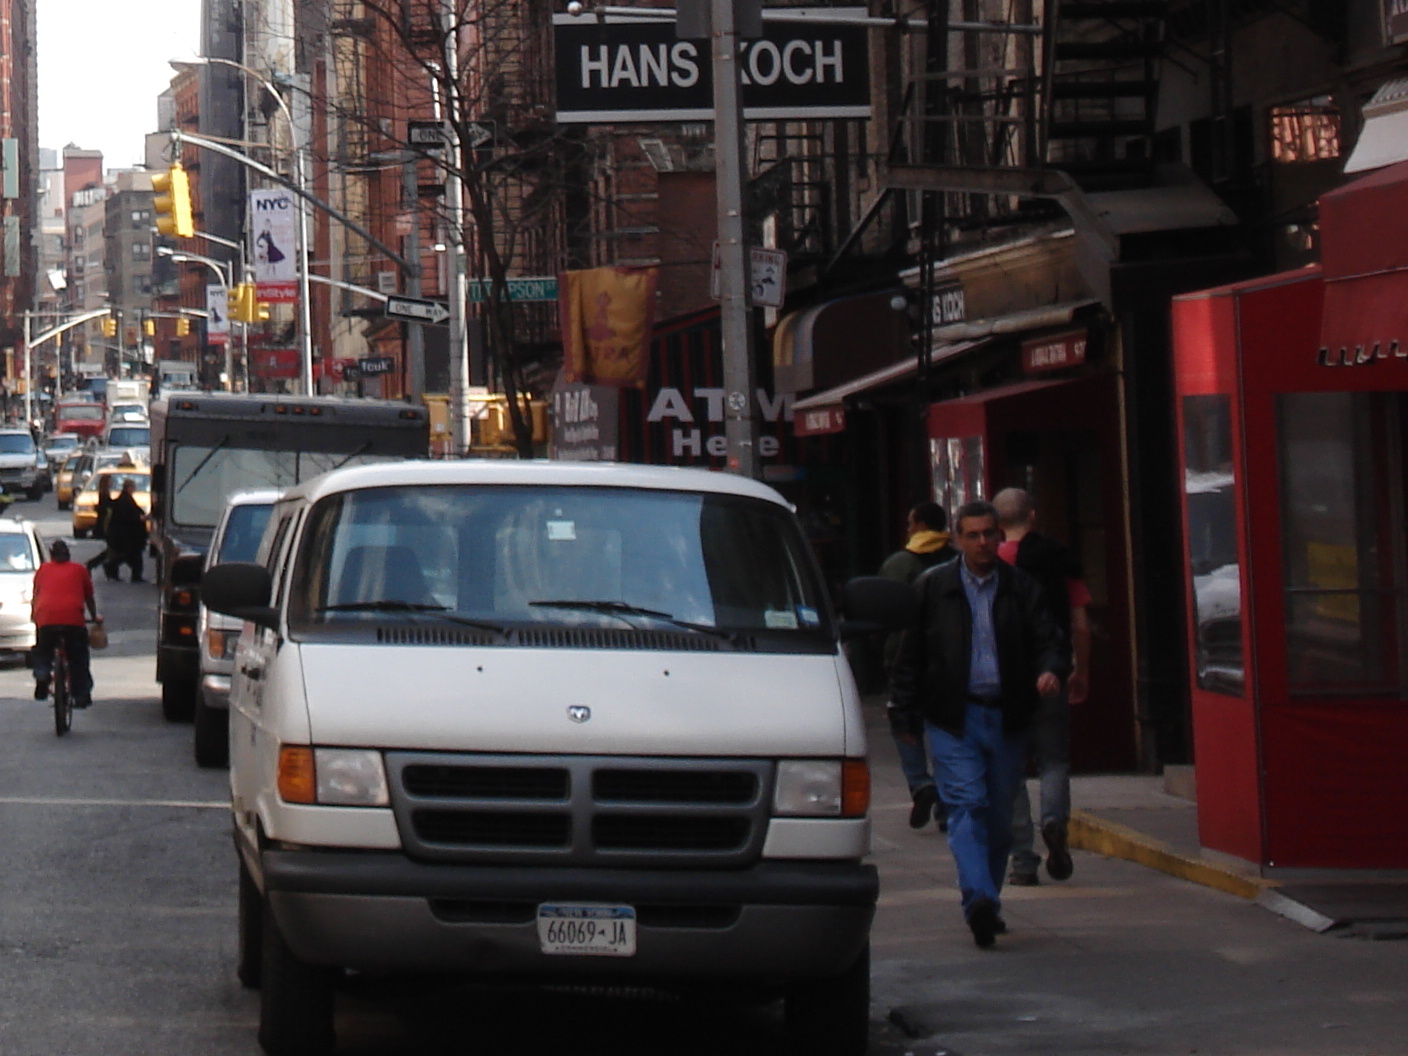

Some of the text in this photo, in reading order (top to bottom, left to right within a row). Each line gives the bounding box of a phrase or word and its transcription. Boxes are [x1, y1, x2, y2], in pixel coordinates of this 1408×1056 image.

[580, 42, 699, 88] HANS
[256, 198, 289, 211] NYC
[396, 301, 413, 313] ONE
[361, 360, 388, 373] fcuk
[672, 428, 781, 457] Hee
